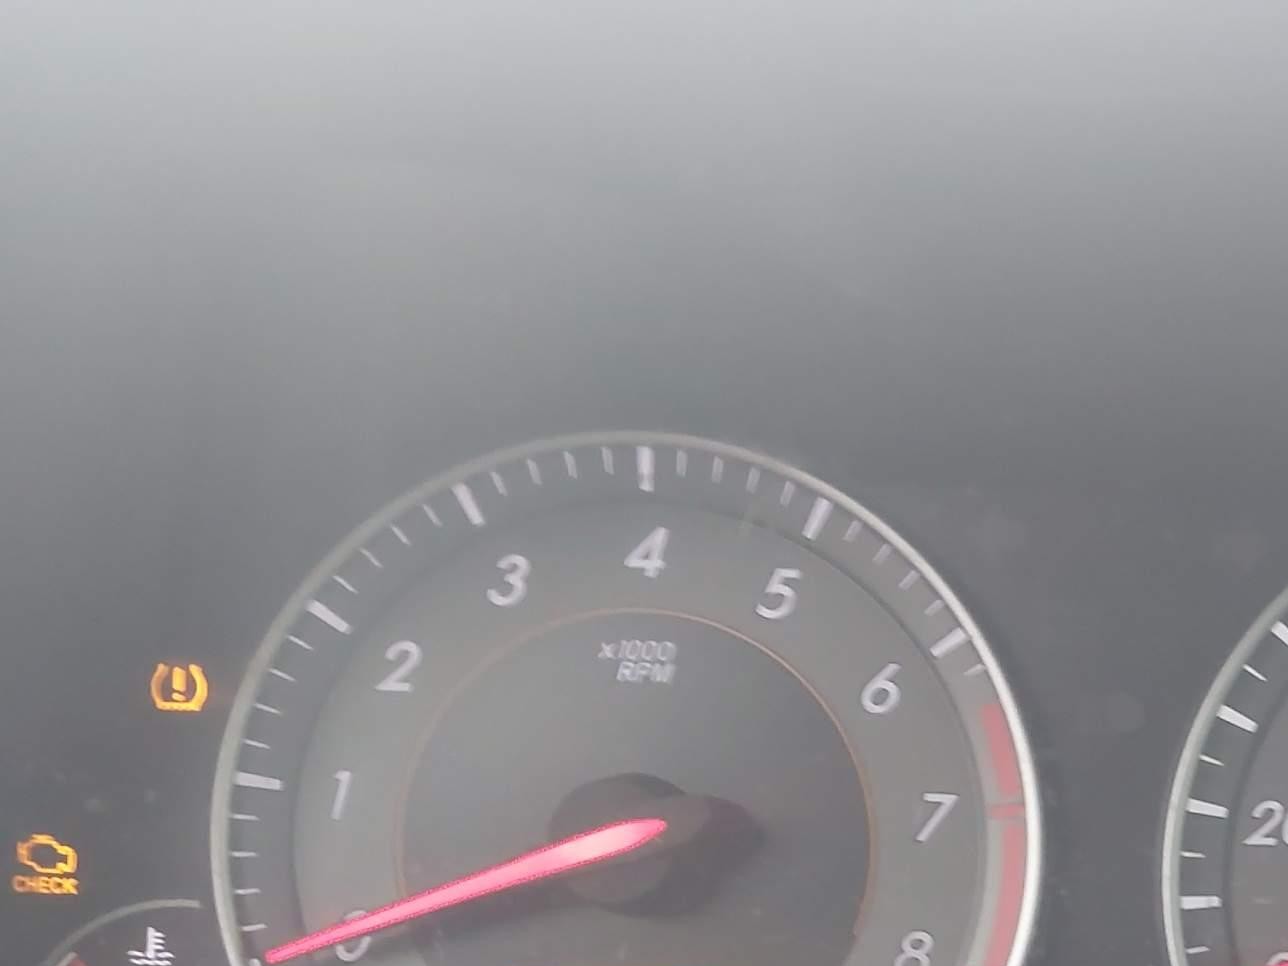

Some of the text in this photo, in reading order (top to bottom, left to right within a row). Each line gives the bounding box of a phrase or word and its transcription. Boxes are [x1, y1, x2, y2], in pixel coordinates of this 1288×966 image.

[624, 527, 669, 578] 4
[487, 554, 532, 606] 3
[755, 567, 801, 620] 5
[374, 640, 423, 692] 2
[616, 661, 676, 683] RPM
[860, 662, 901, 715] 6
[330, 769, 353, 821] 1
[914, 792, 960, 843] 7
[11, 875, 80, 895] CHECK
